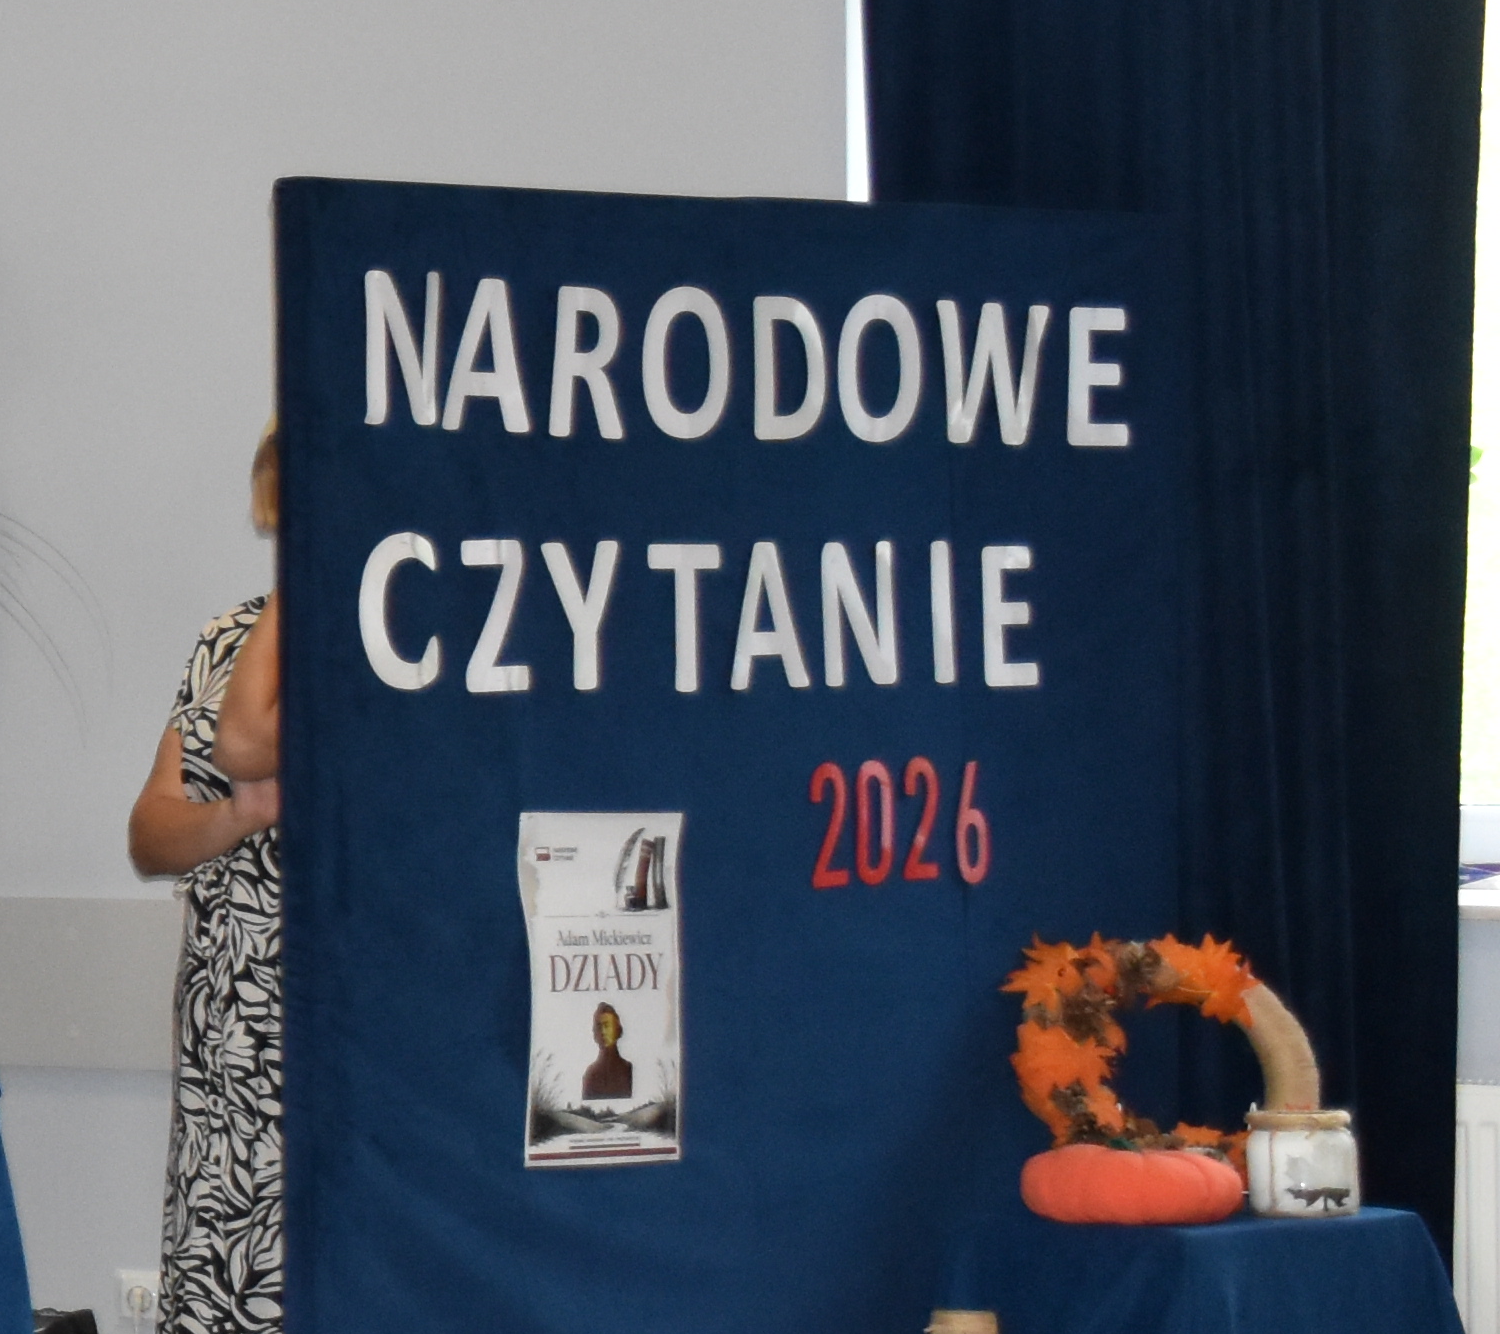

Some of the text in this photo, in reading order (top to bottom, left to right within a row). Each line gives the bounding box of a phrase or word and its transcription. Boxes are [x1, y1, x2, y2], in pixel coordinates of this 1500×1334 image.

[363, 269, 1131, 447] NARODOWE
[358, 531, 1040, 693] CZYTANIE
[808, 755, 991, 889] 2026
[549, 953, 663, 992] DZIADY
[557, 930, 652, 946] Adam Mickiewicz
